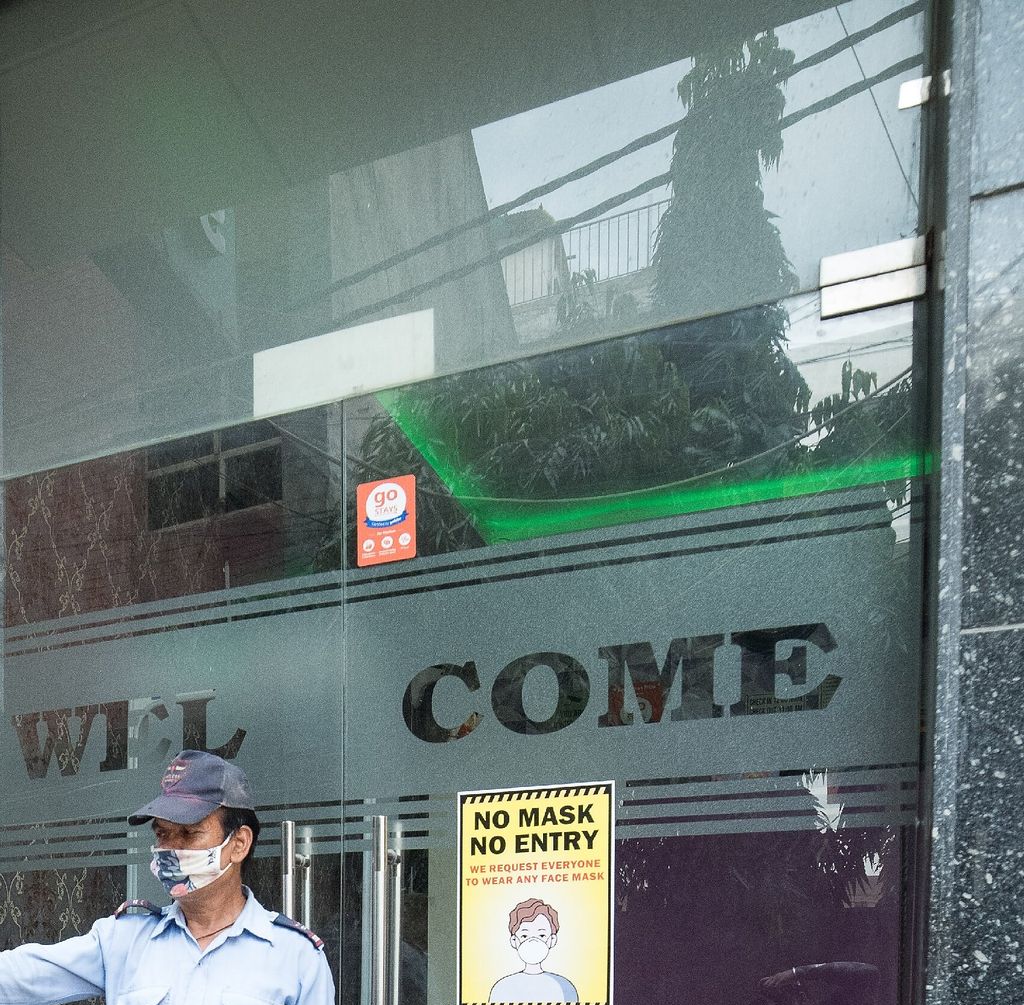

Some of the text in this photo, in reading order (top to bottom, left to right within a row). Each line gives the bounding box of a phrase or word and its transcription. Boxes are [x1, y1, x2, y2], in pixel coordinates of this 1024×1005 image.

[374, 489, 398, 507] go
[403, 622, 843, 744] COME
[474, 803, 595, 831] NO MASK
[470, 830, 599, 856] NO ENTRY
[470, 859, 601, 874] WE REQUEST EVERYONE
[466, 871, 605, 886] TO WEAR ANY FACE MASK
